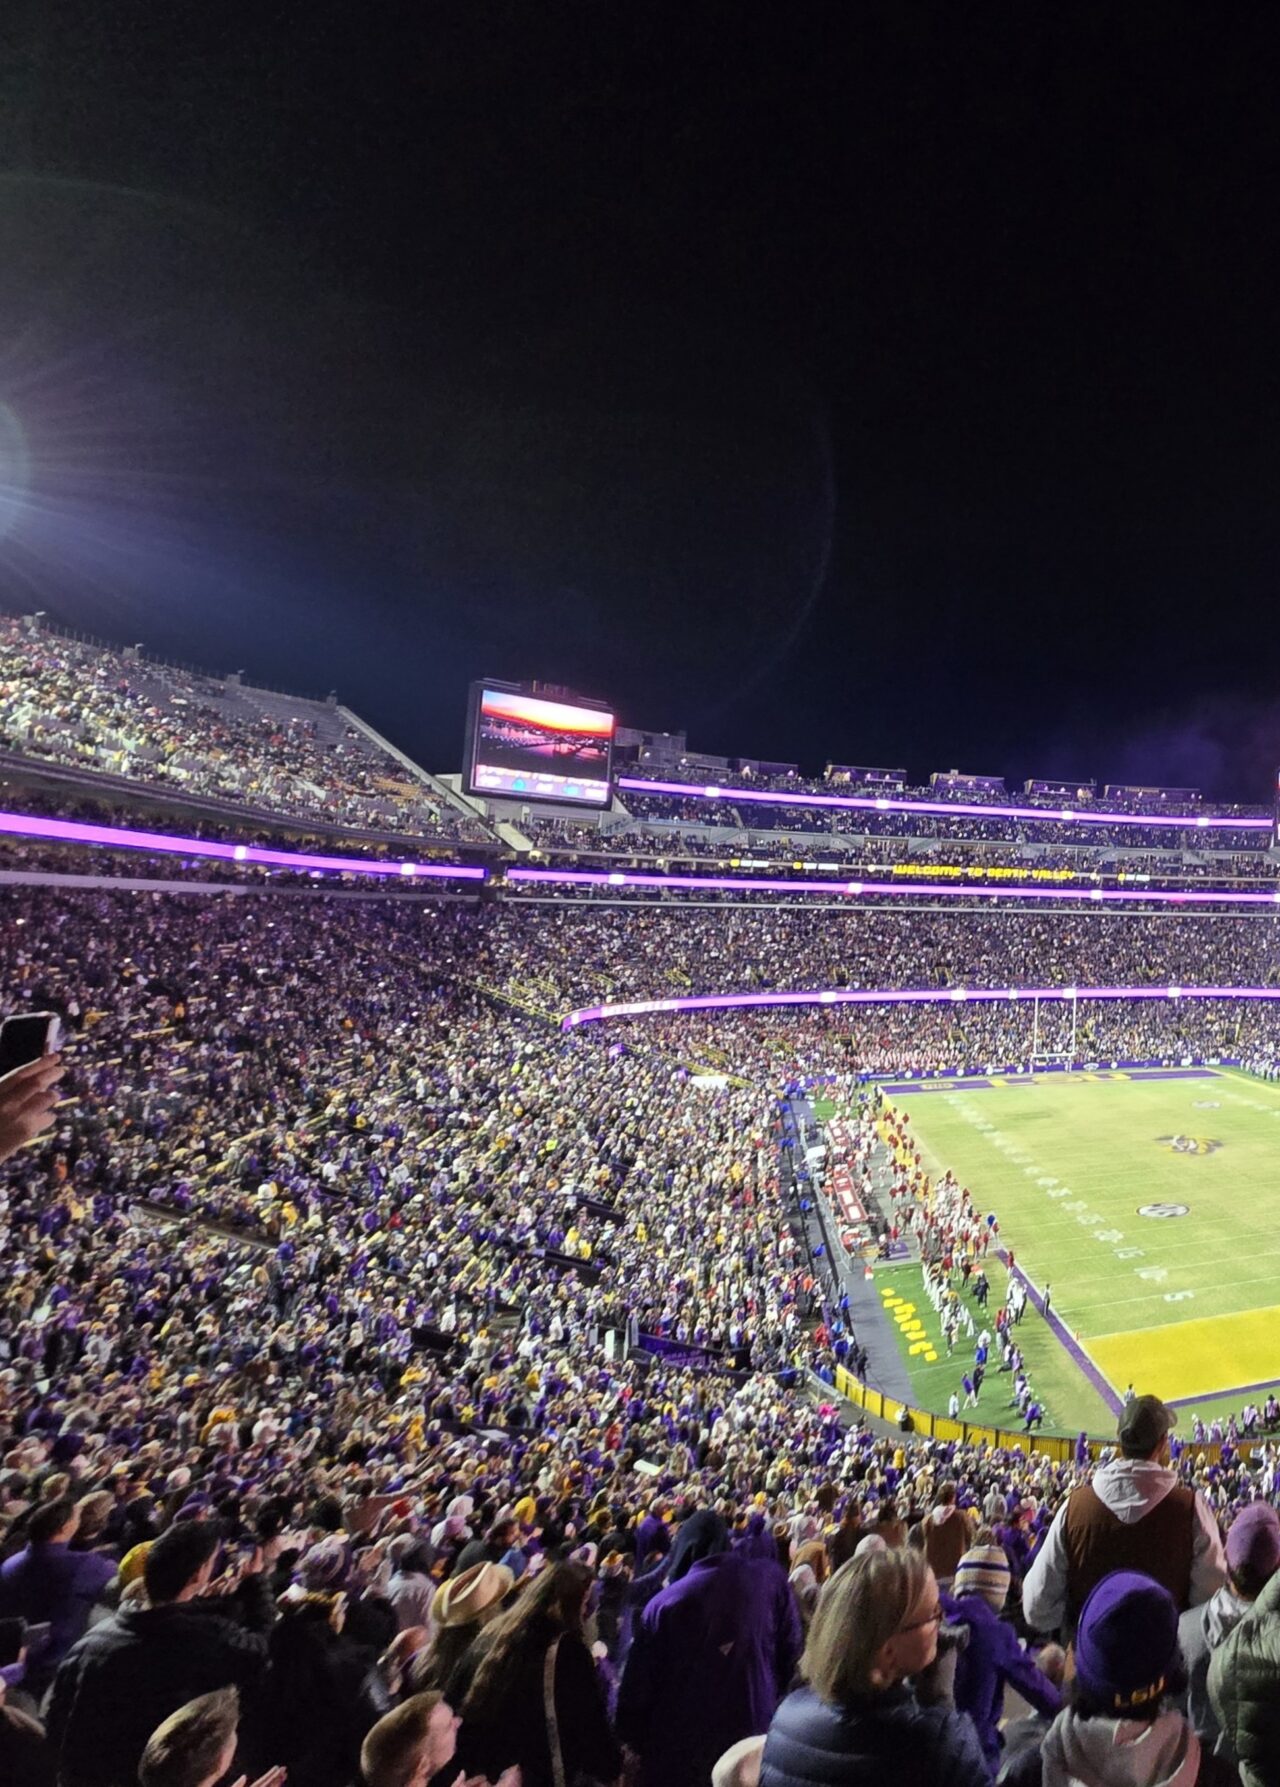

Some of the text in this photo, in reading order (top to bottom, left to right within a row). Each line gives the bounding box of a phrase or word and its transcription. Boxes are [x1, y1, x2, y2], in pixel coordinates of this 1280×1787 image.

[893, 865, 1076, 880] WELCOME TO DEATH VALLEY
[1114, 1675, 1165, 1708] LSU
